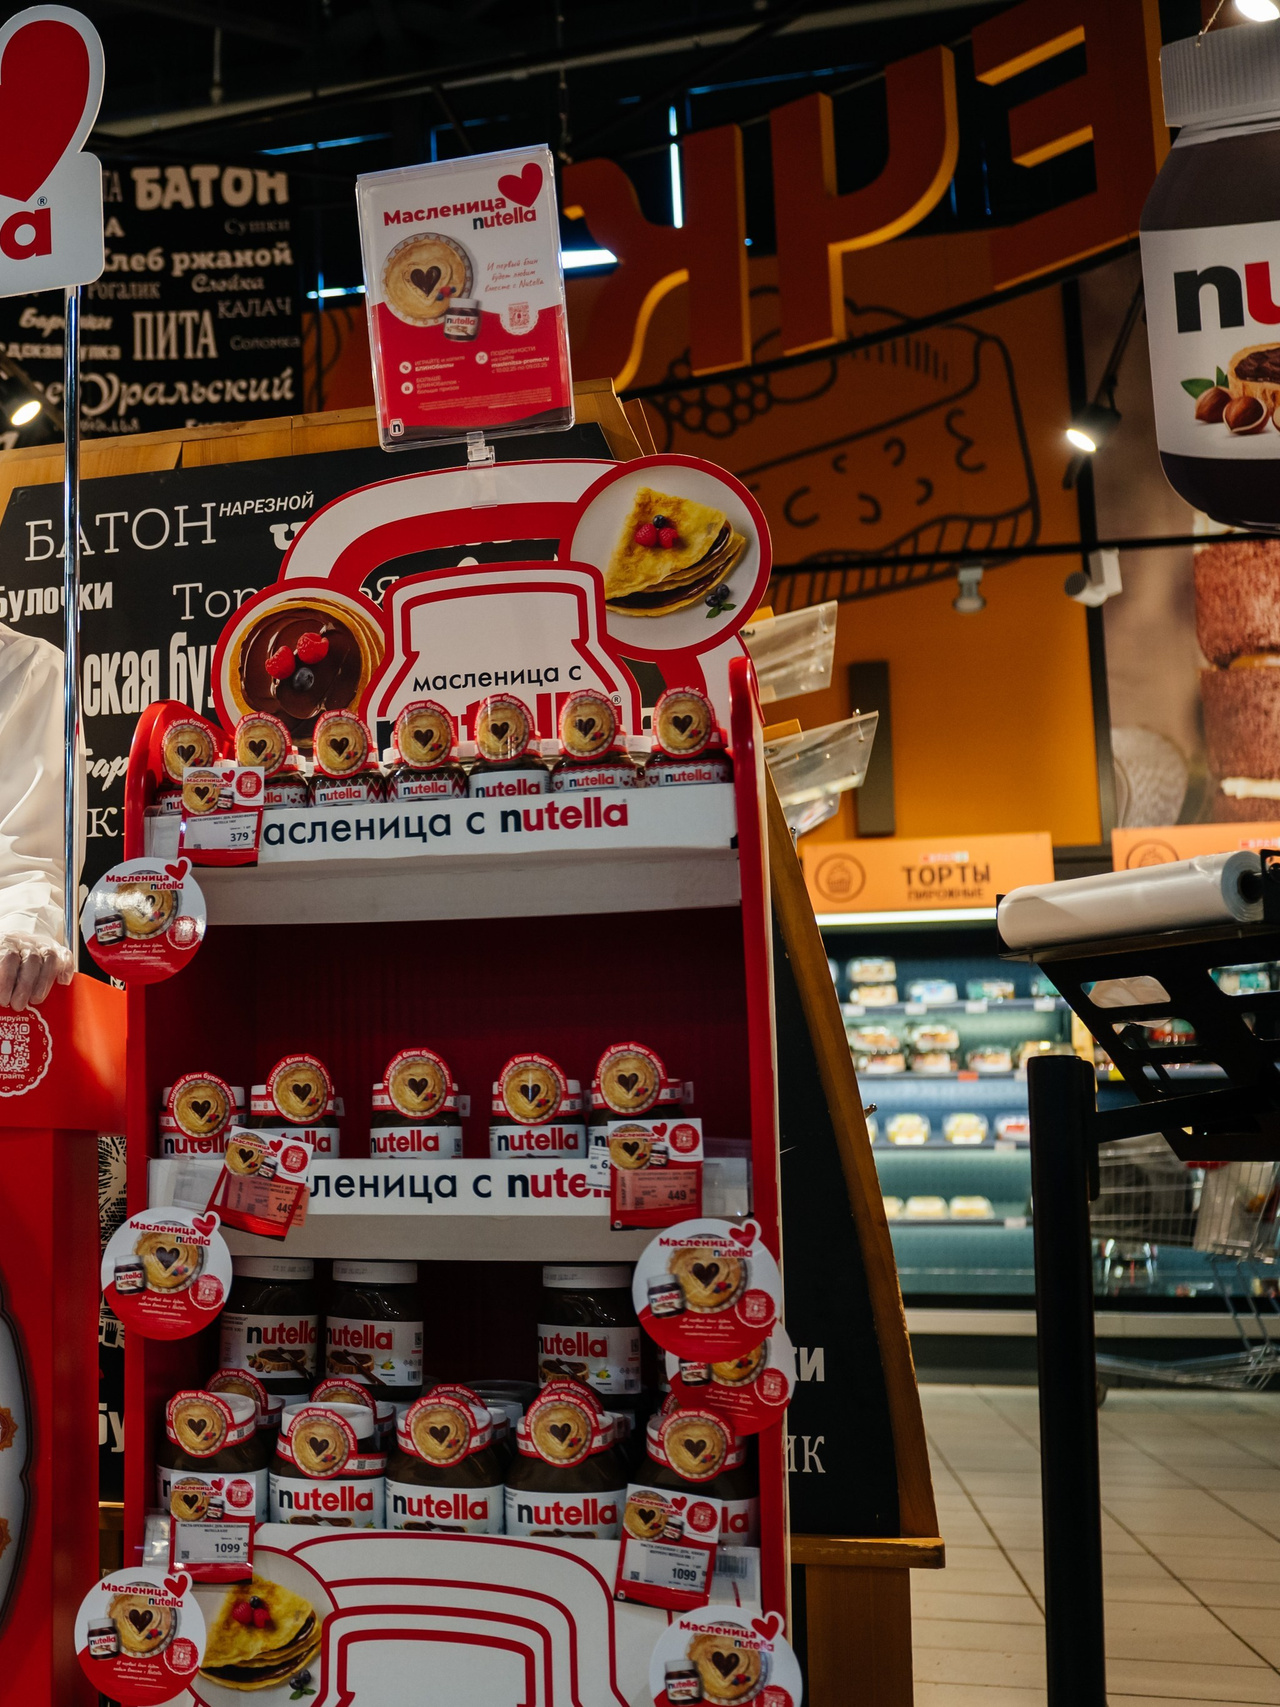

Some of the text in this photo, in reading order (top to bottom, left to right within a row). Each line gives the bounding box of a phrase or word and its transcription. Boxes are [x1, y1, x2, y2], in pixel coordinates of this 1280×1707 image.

[131, 164, 289, 211] БАТОН
[383, 197, 507, 226] Масленица
[473, 206, 537, 230] nutella
[171, 241, 294, 277] ржаной
[218, 297, 292, 318] КАЛАЧ
[133, 309, 218, 360] ПИТА
[80, 366, 294, 417] Уральский
[219, 490, 315, 518] НАРЕЗНОЙ
[25, 502, 217, 562] БАТОН
[83, 649, 161, 717] ская
[413, 664, 582, 692] масленица с
[569, 773, 614, 787] nutella
[665, 769, 712, 782] nutella
[320, 787, 362, 802] nutella
[404, 782, 447, 795] nutella
[476, 779, 540, 797] nutella
[500, 797, 629, 833] nutella
[264, 807, 485, 846] асленица с
[230, 832, 249, 842] 379
[105, 874, 170, 883] Масленица
[902, 862, 990, 886] ТОРТЫ
[151, 881, 184, 890] nutella
[402, 1049, 439, 1062] блин будет
[610, 1043, 650, 1057] блин будет
[304, 1055, 322, 1068] будет
[514, 1055, 532, 1063] блин
[203, 1072, 222, 1084] будет
[497, 1127, 579, 1151] nutella
[307, 1173, 457, 1203] леница
[472, 1174, 492, 1199] с
[508, 1167, 611, 1199] nute
[668, 1189, 687, 1201] 449
[129, 1220, 197, 1236] Масленица
[175, 1235, 211, 1247] nutella
[659, 1238, 735, 1248] Масленица
[713, 1248, 753, 1258] nutella
[181, 1391, 217, 1403] блин будет
[540, 1393, 581, 1405] блин будет
[308, 1408, 345, 1426] блин будет
[278, 1486, 374, 1512] nutella
[393, 1494, 488, 1521] nutella
[517, 1498, 618, 1526] nutella
[214, 1543, 241, 1553] 1099
[672, 1567, 697, 1581] 1099
[101, 1582, 169, 1597] Масленица
[148, 1596, 184, 1608] nutella
[680, 1621, 757, 1639] Масленица
[734, 1639, 775, 1652] nutella
